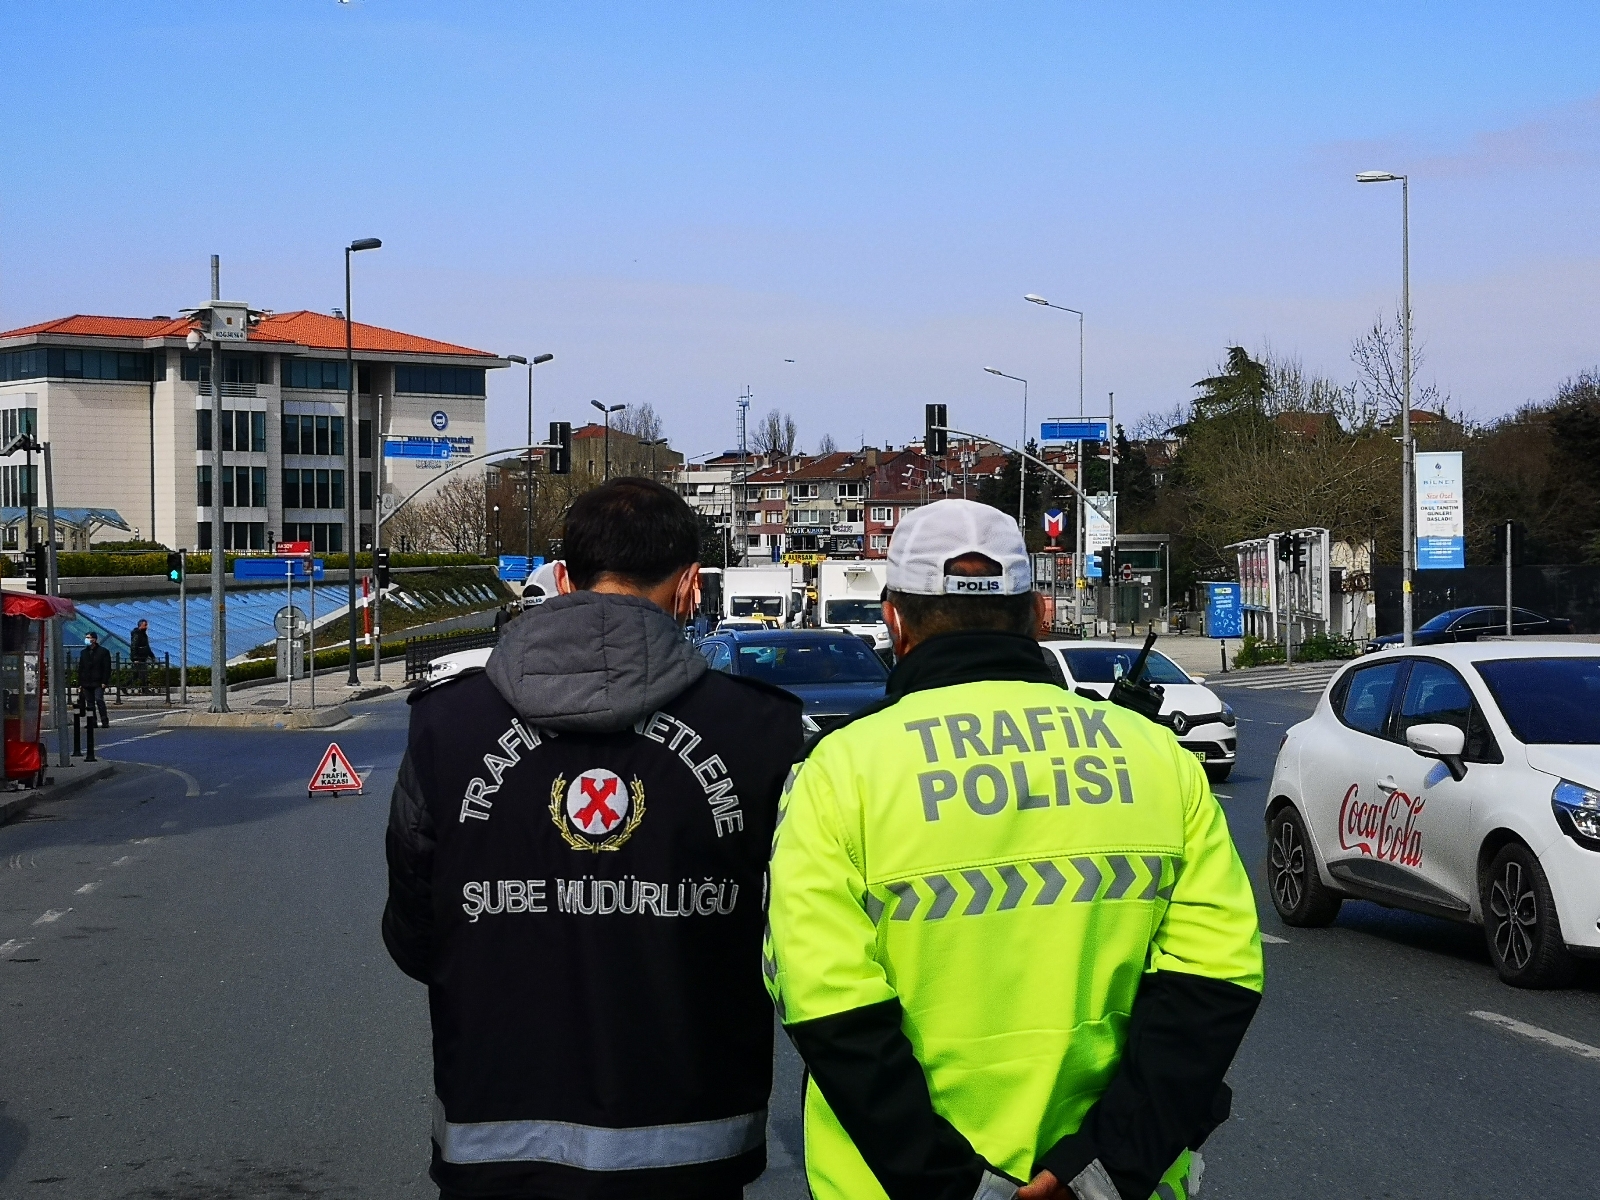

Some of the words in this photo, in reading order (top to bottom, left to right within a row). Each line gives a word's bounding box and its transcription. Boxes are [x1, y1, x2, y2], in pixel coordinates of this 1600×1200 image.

[634, 711, 744, 838] ETLEME
[462, 879, 548, 923] ŞUBE
[555, 874, 739, 917] MÜDÜRLÜĞÜ
